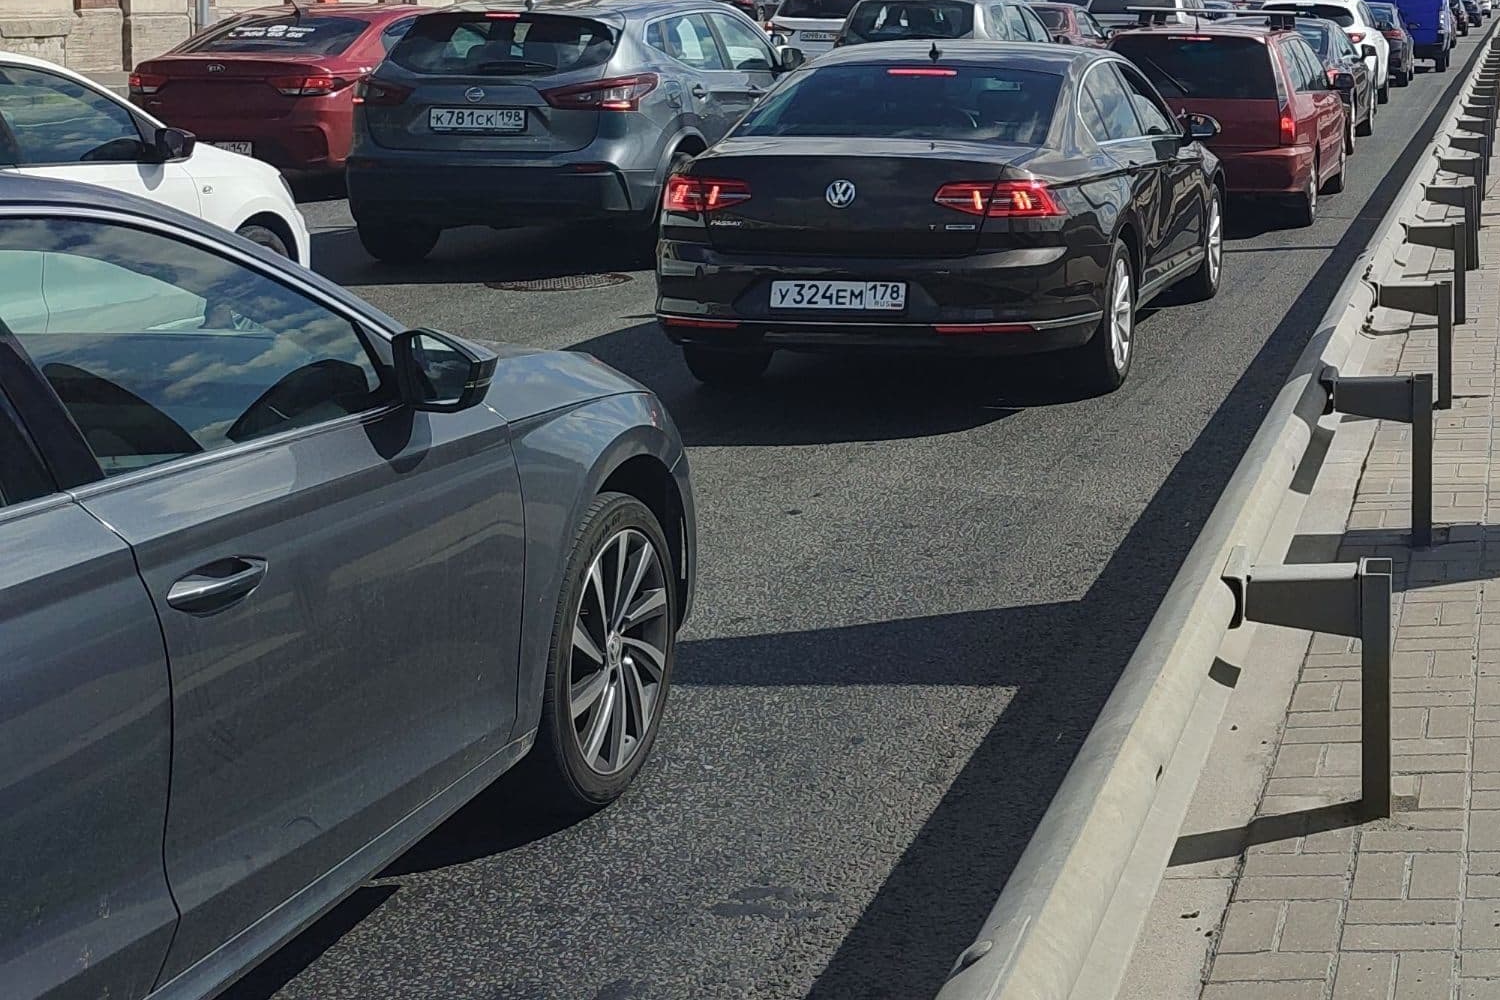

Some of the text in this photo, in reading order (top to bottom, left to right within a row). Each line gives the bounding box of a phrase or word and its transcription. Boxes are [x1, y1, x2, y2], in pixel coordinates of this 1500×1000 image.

[499, 111, 521, 122] 198
[778, 283, 900, 306] У324ЕМ 178
